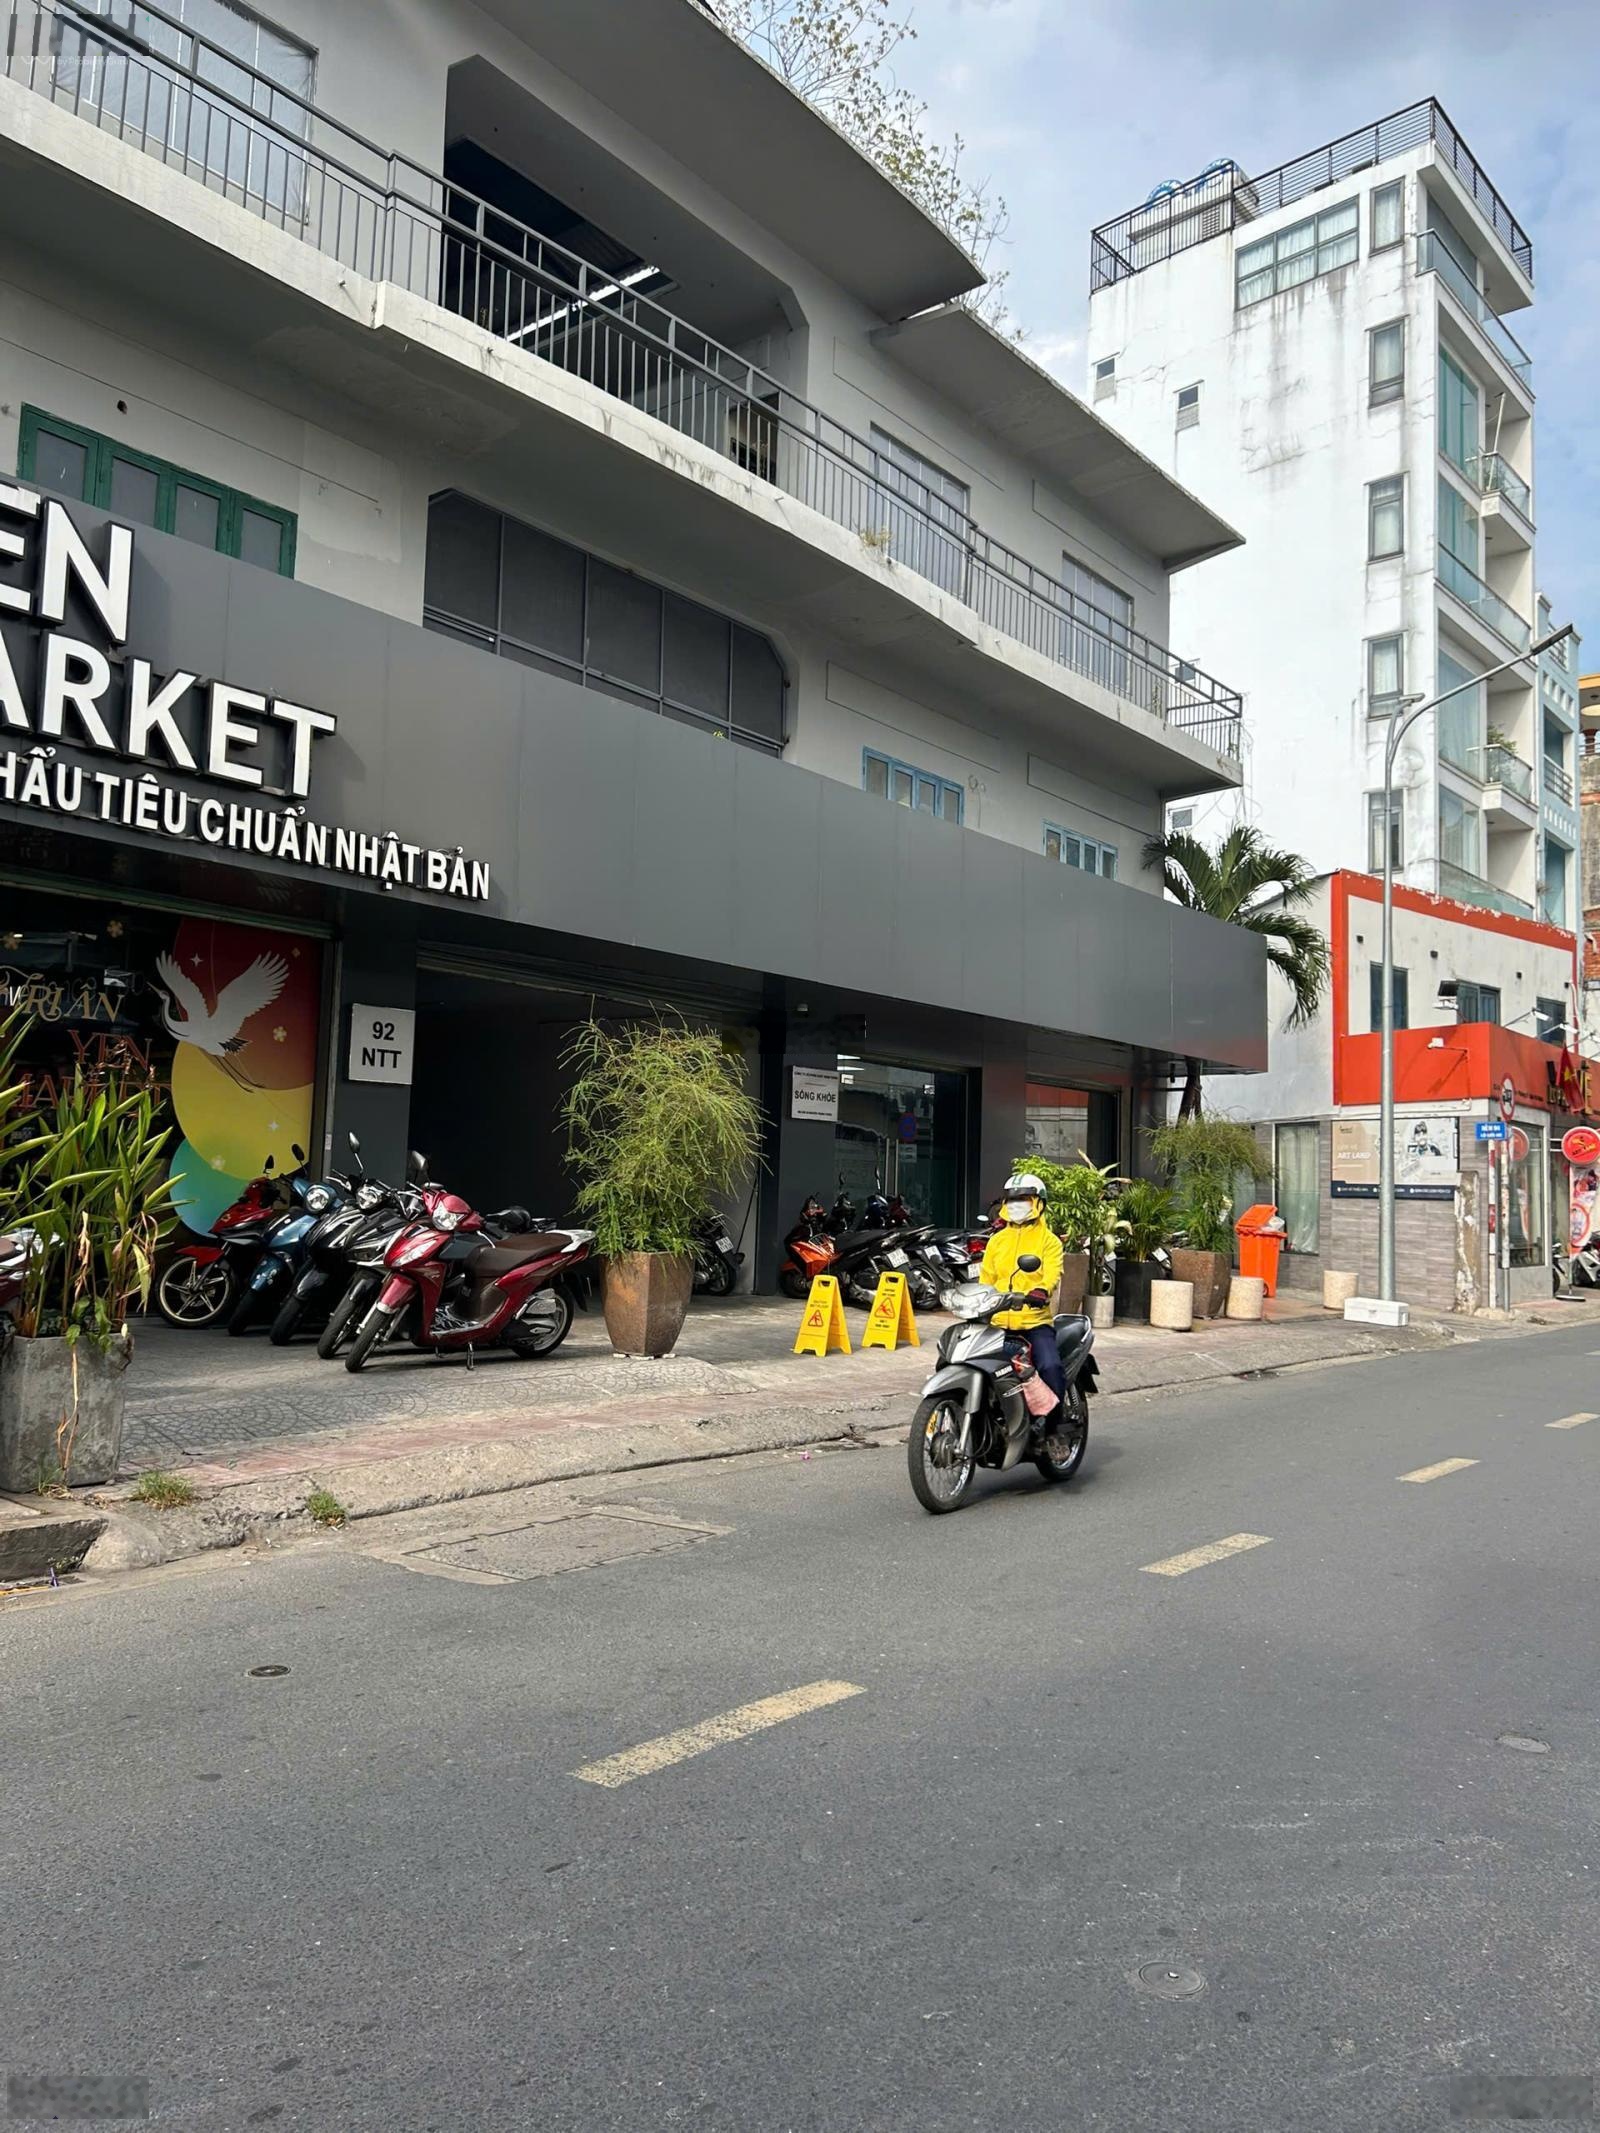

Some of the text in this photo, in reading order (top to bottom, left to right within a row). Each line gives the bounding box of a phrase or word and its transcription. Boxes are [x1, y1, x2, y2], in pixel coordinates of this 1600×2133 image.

[96, 772, 187, 834] TIÊU
[200, 799, 327, 867] CHUẨN
[335, 828, 420, 890] NHẬT
[424, 845, 490, 901] BẢN
[372, 1021, 395, 1041] 92
[362, 1047, 402, 1070] NTT
